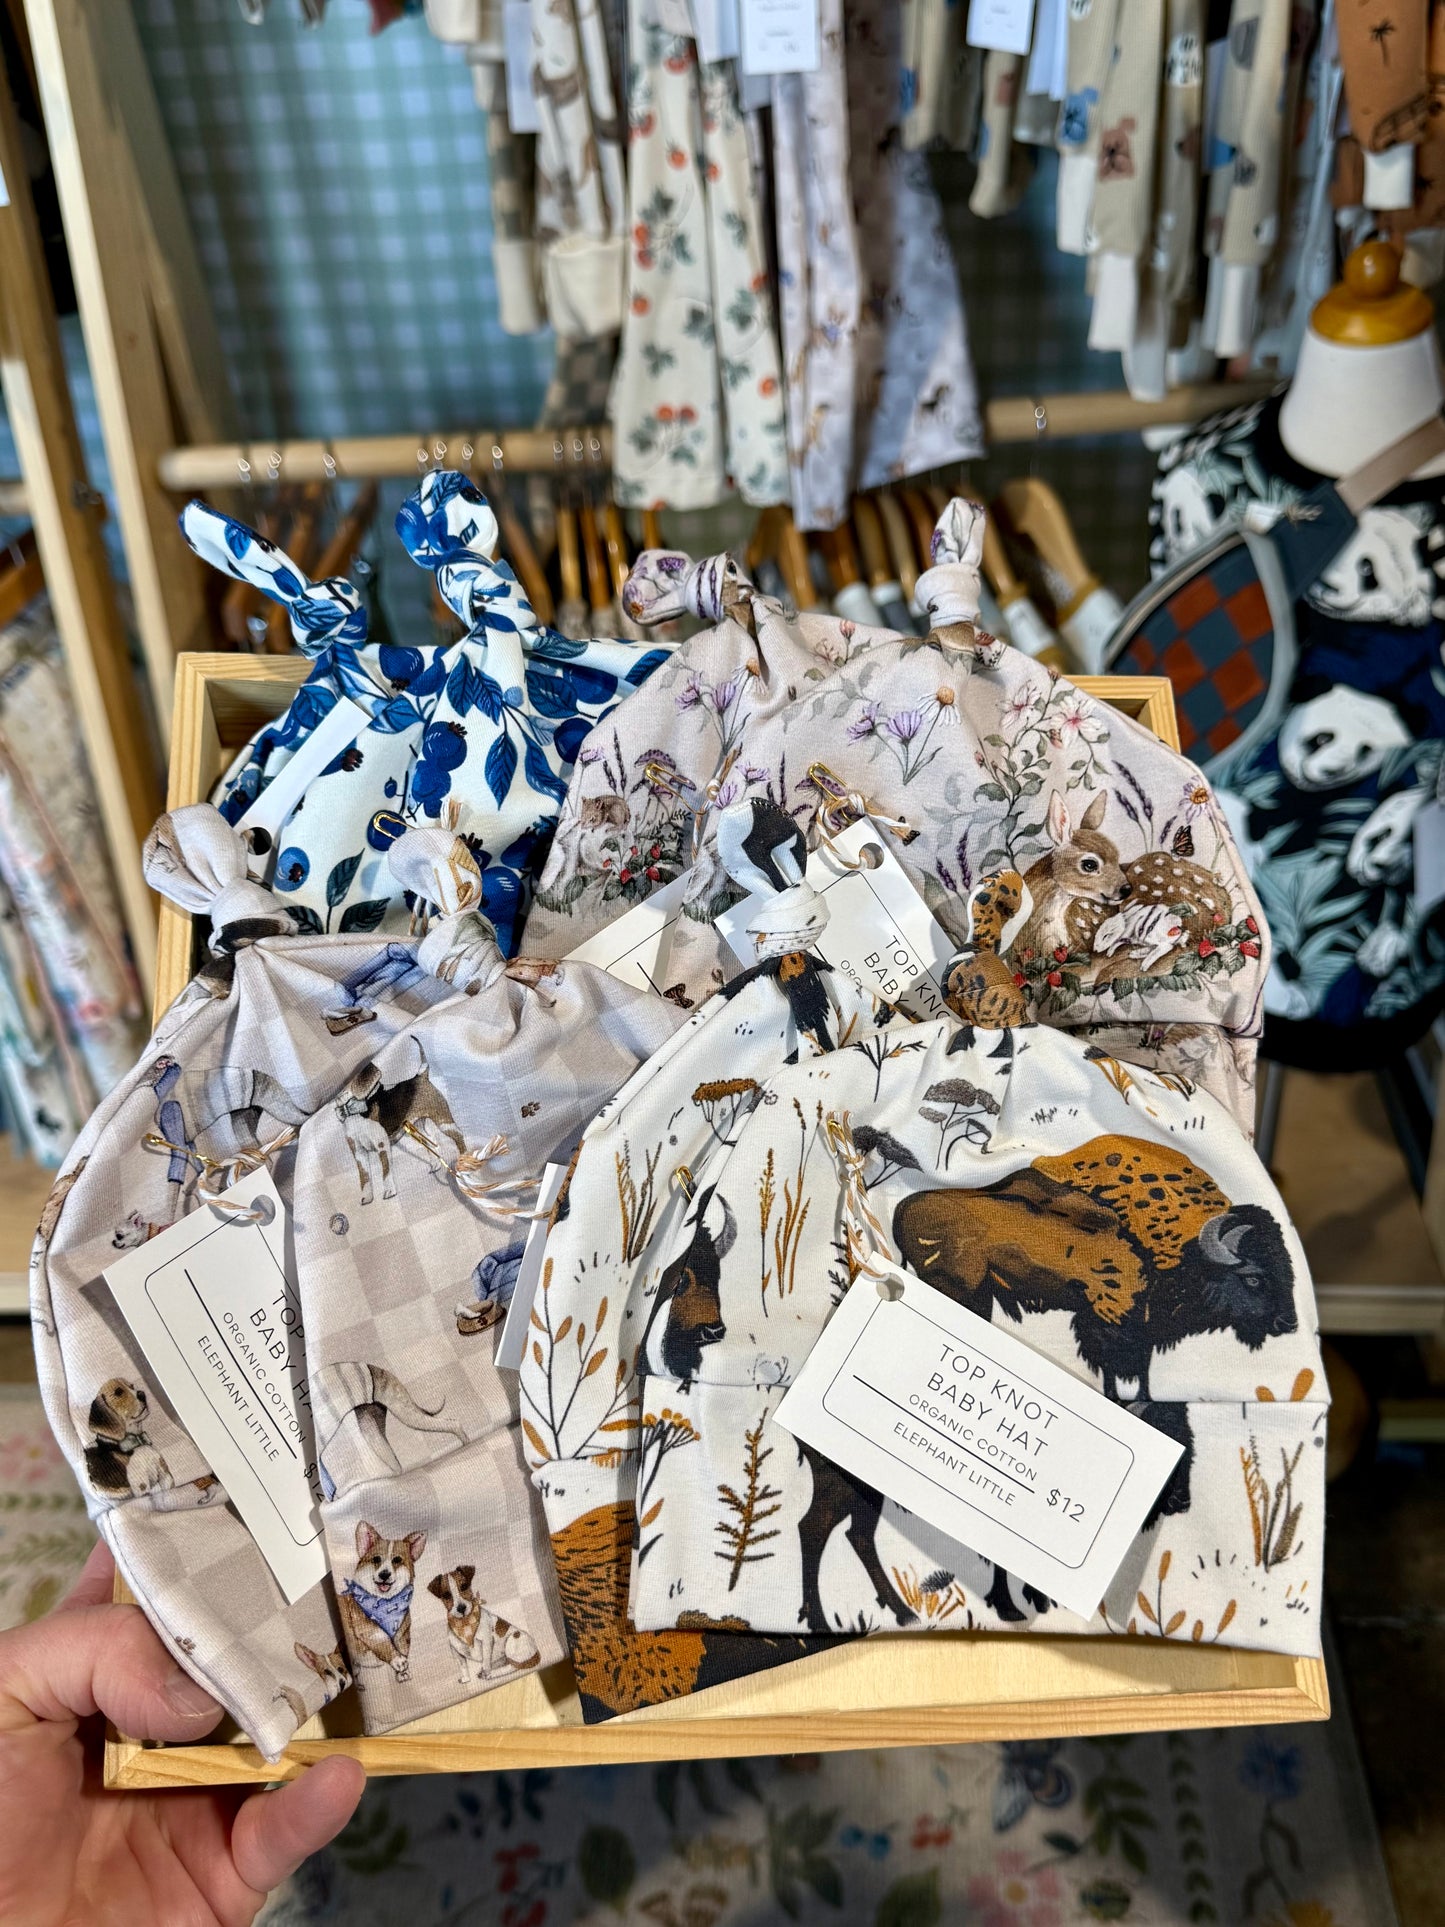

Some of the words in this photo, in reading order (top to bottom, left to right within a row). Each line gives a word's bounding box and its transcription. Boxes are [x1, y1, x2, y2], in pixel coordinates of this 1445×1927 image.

[864, 952, 909, 1005] BABY
[886, 935, 918, 976] TOP
[915, 982, 950, 1019] KNO
[250, 1308, 297, 1372] BABY
[273, 1289, 304, 1339] TOP
[198, 1335, 249, 1411] ELEPHANT
[244, 1413, 280, 1461] LITTLE
[223, 1312, 266, 1380] ORGANIC
[265, 1382, 306, 1443] COTTON
[927, 1371, 993, 1421] BABY
[996, 1416, 1048, 1457] HAT
[940, 1342, 986, 1381] TOP
[990, 1379, 1058, 1429] KNOT
[893, 1422, 968, 1475] ELEPHANT
[968, 1469, 1017, 1506] LITTLE
[909, 1393, 974, 1442] ORGANIC
[977, 1437, 1037, 1481] COTTON
[1046, 1488, 1085, 1523] $12
